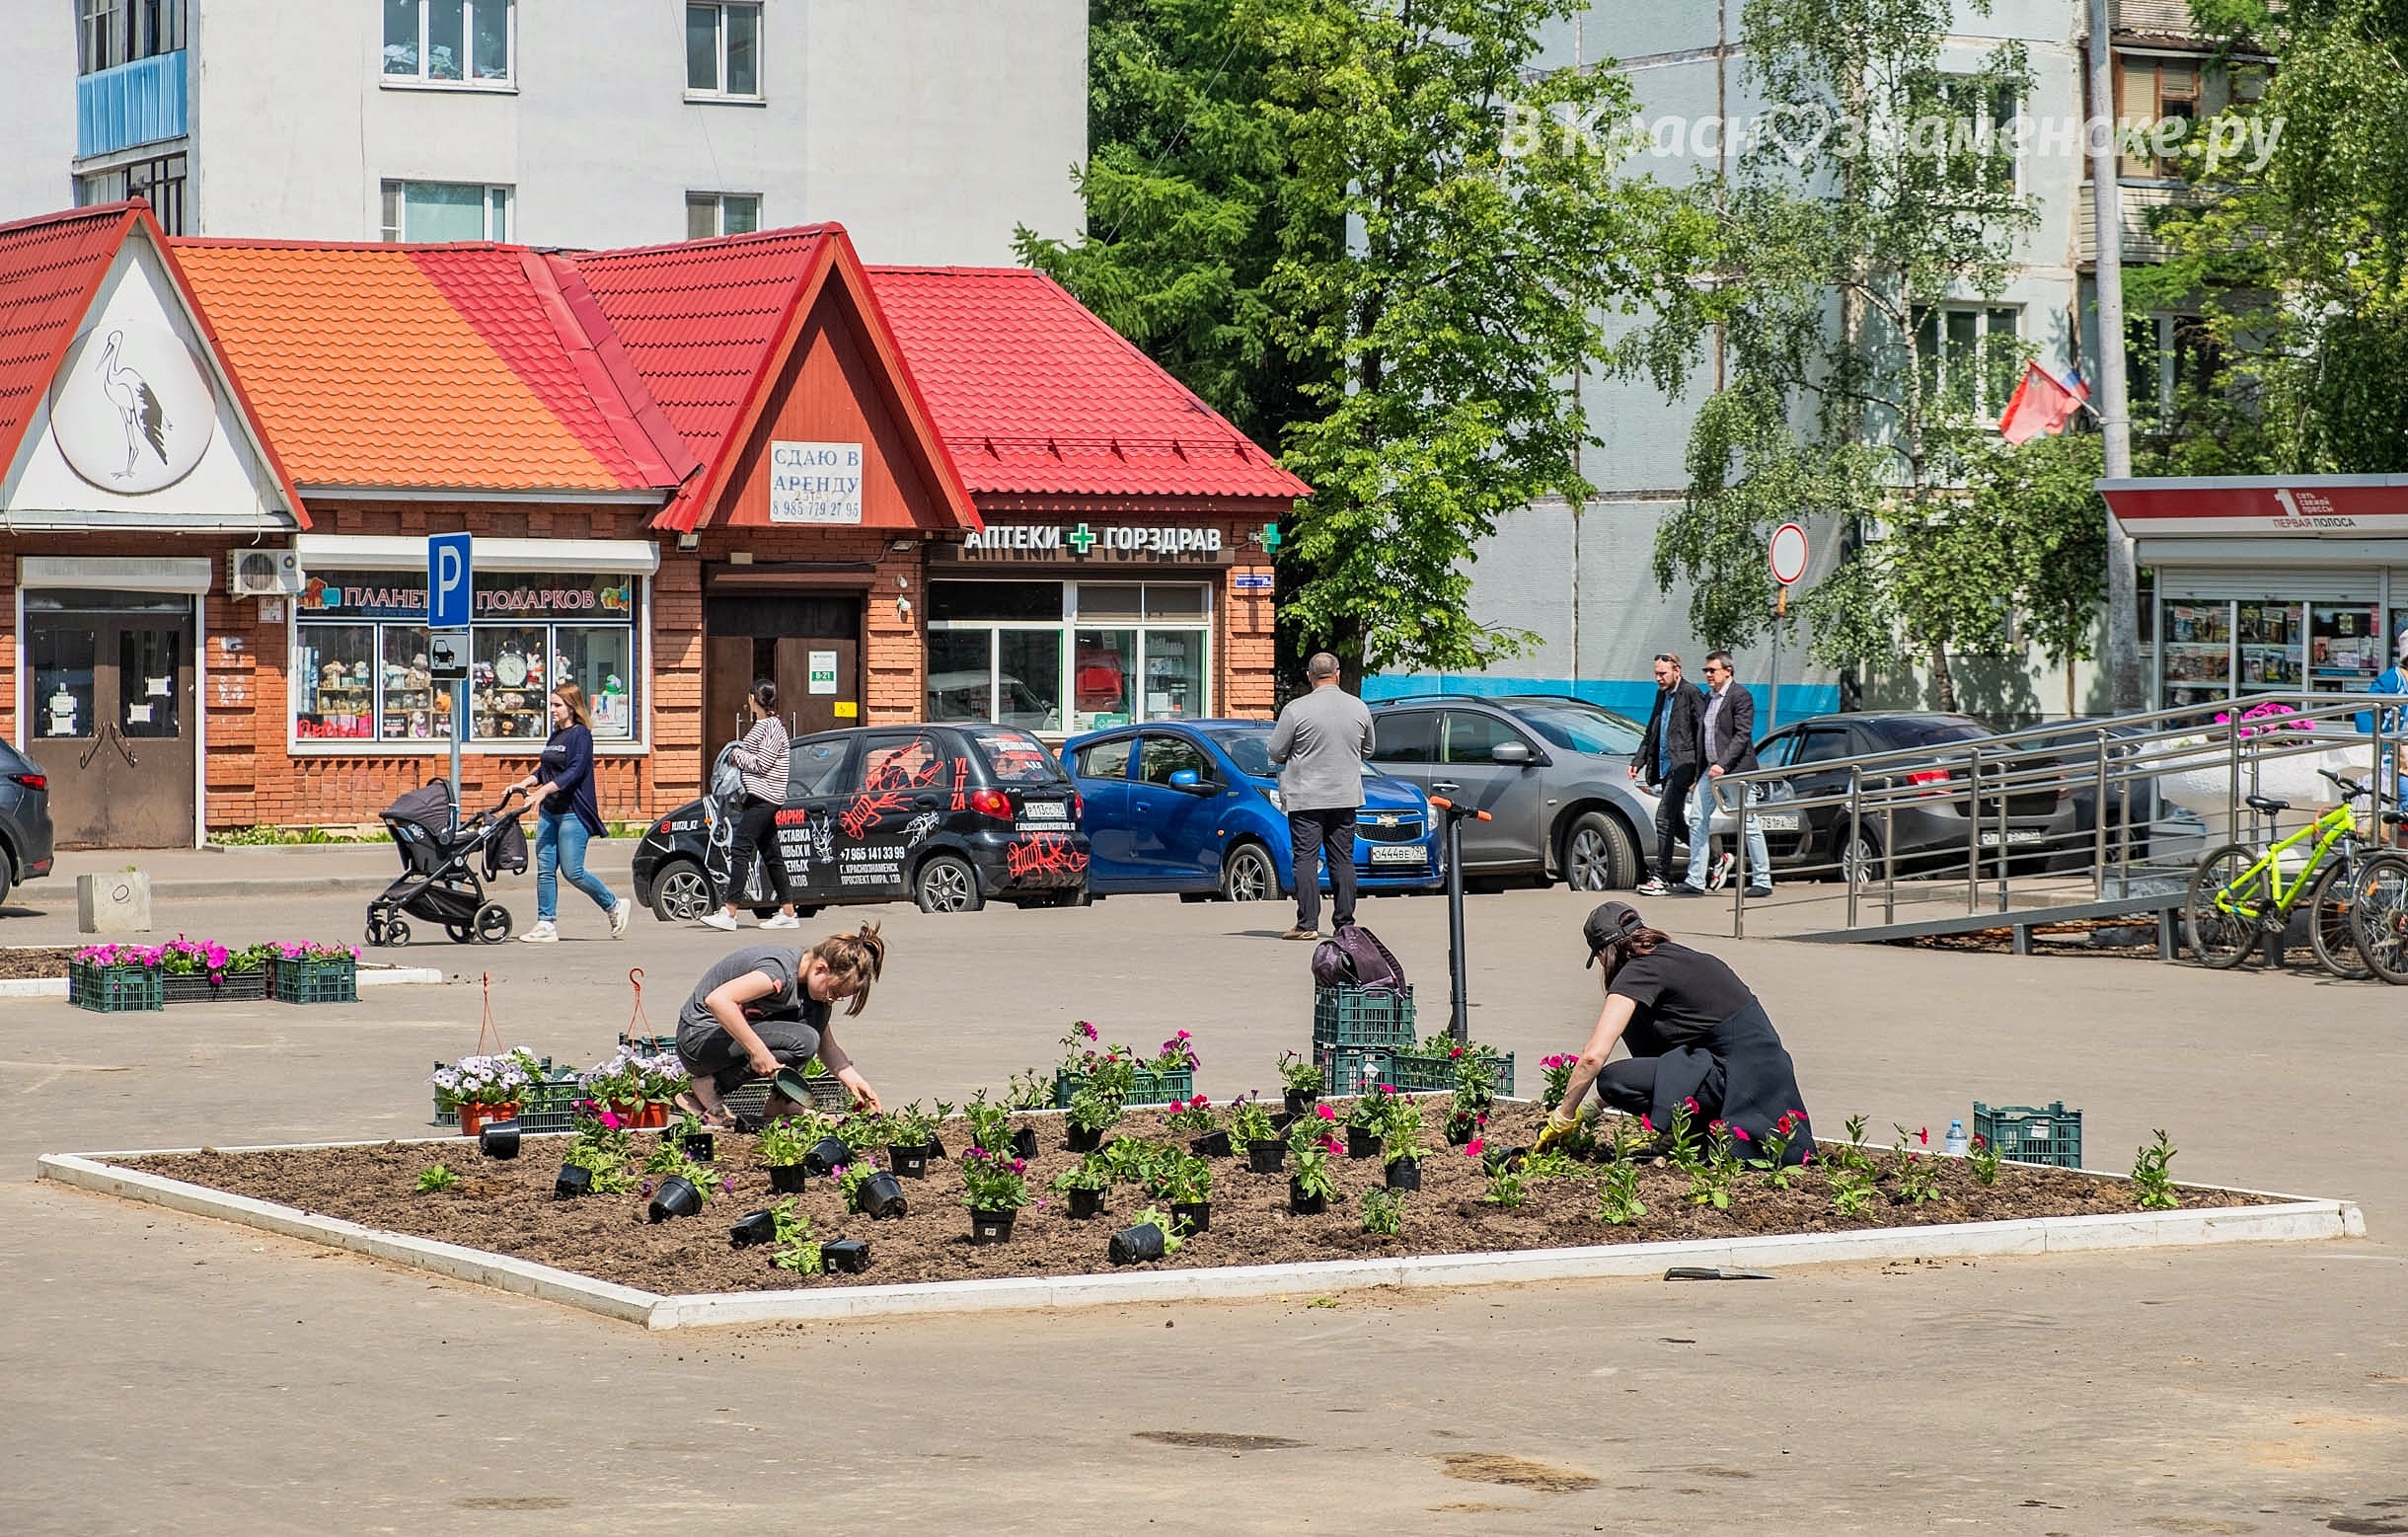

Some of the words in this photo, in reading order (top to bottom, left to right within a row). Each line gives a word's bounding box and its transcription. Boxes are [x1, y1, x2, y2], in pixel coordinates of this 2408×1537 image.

[774, 448, 838, 467] СДАЮ
[847, 451, 860, 467] В
[773, 476, 860, 495] АРЕНДУ
[830, 501, 843, 517] 27
[2274, 489, 2301, 517] 1
[2274, 518, 2313, 529] ПЕРВАЯ
[2313, 517, 2358, 529] ПОЛОСА
[963, 525, 1061, 550] АПТЕКИ
[1103, 526, 1222, 554] ГОРЗДРАВ
[438, 545, 462, 617] P
[343, 586, 428, 609] ПЛАНЕТ
[476, 590, 596, 609] ПОДАРКОВ
[777, 828, 811, 843] ОСТАВКА
[840, 848, 850, 861] +7
[851, 847, 866, 861] 965
[867, 847, 882, 860] 141
[882, 846, 893, 860] 33
[894, 846, 905, 859] 99
